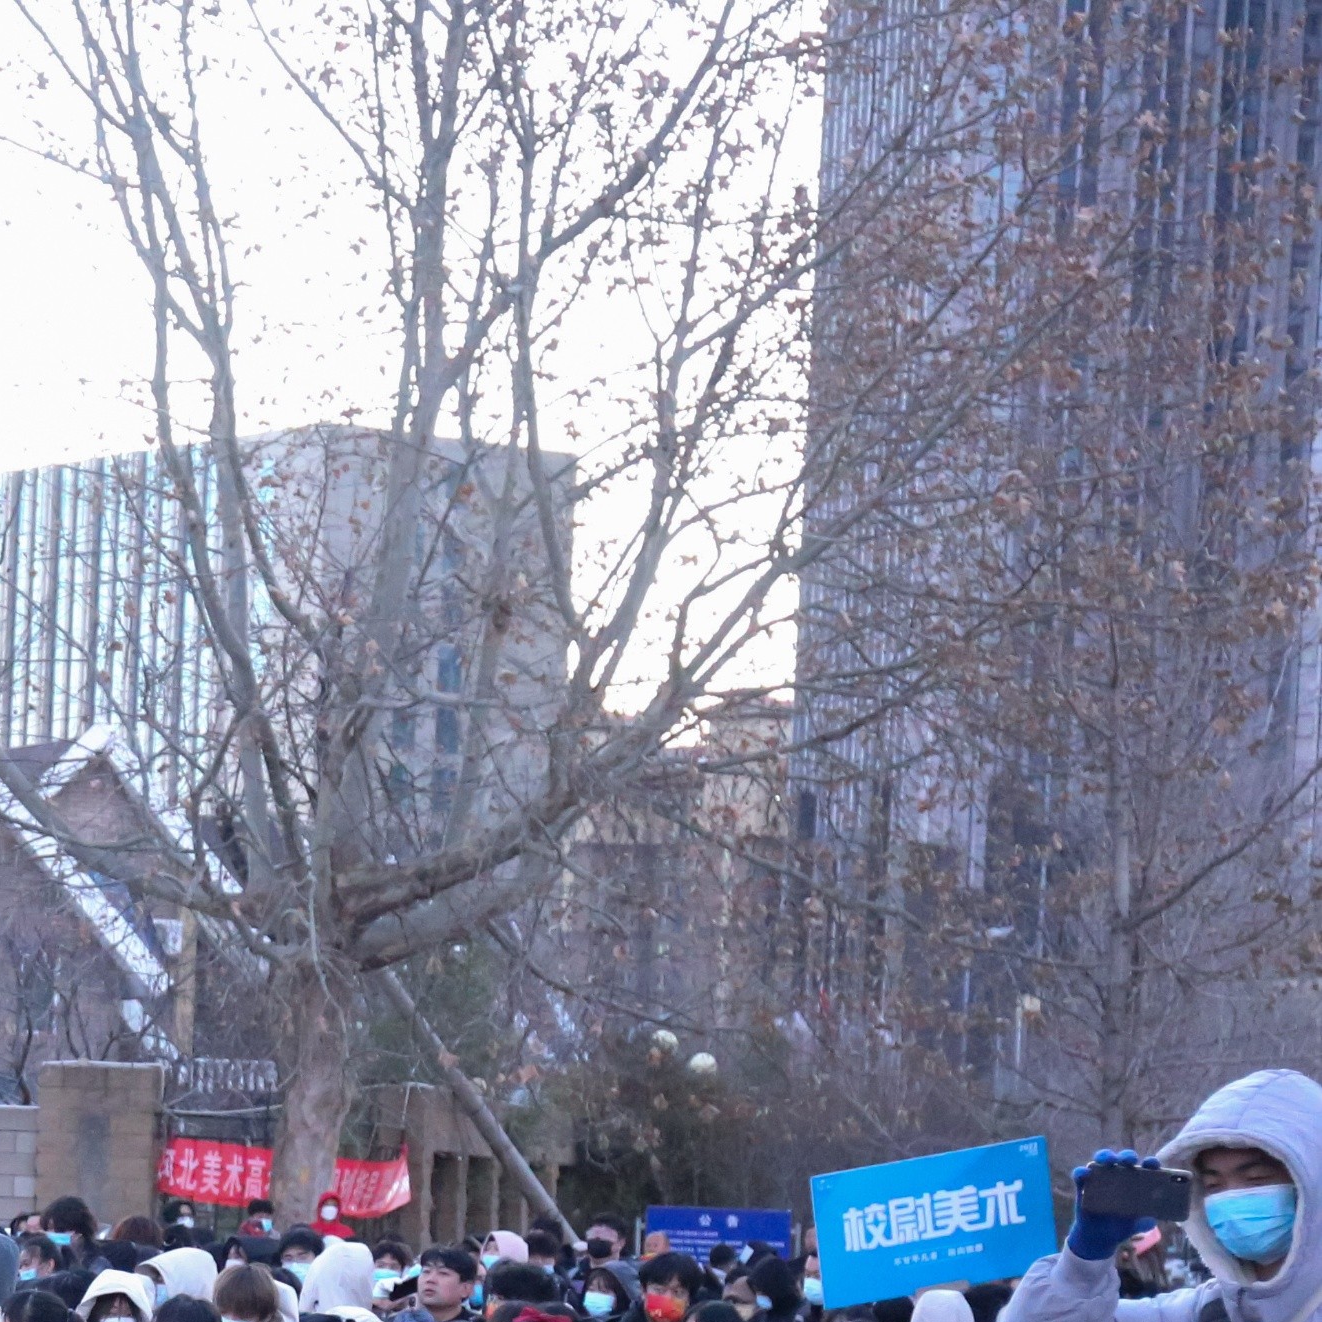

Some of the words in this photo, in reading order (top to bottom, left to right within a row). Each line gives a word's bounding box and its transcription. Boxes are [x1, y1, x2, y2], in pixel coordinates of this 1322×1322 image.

[158, 1147, 272, 1201] 河北美术高
[843, 1179, 1026, 1252] 校尉美术
